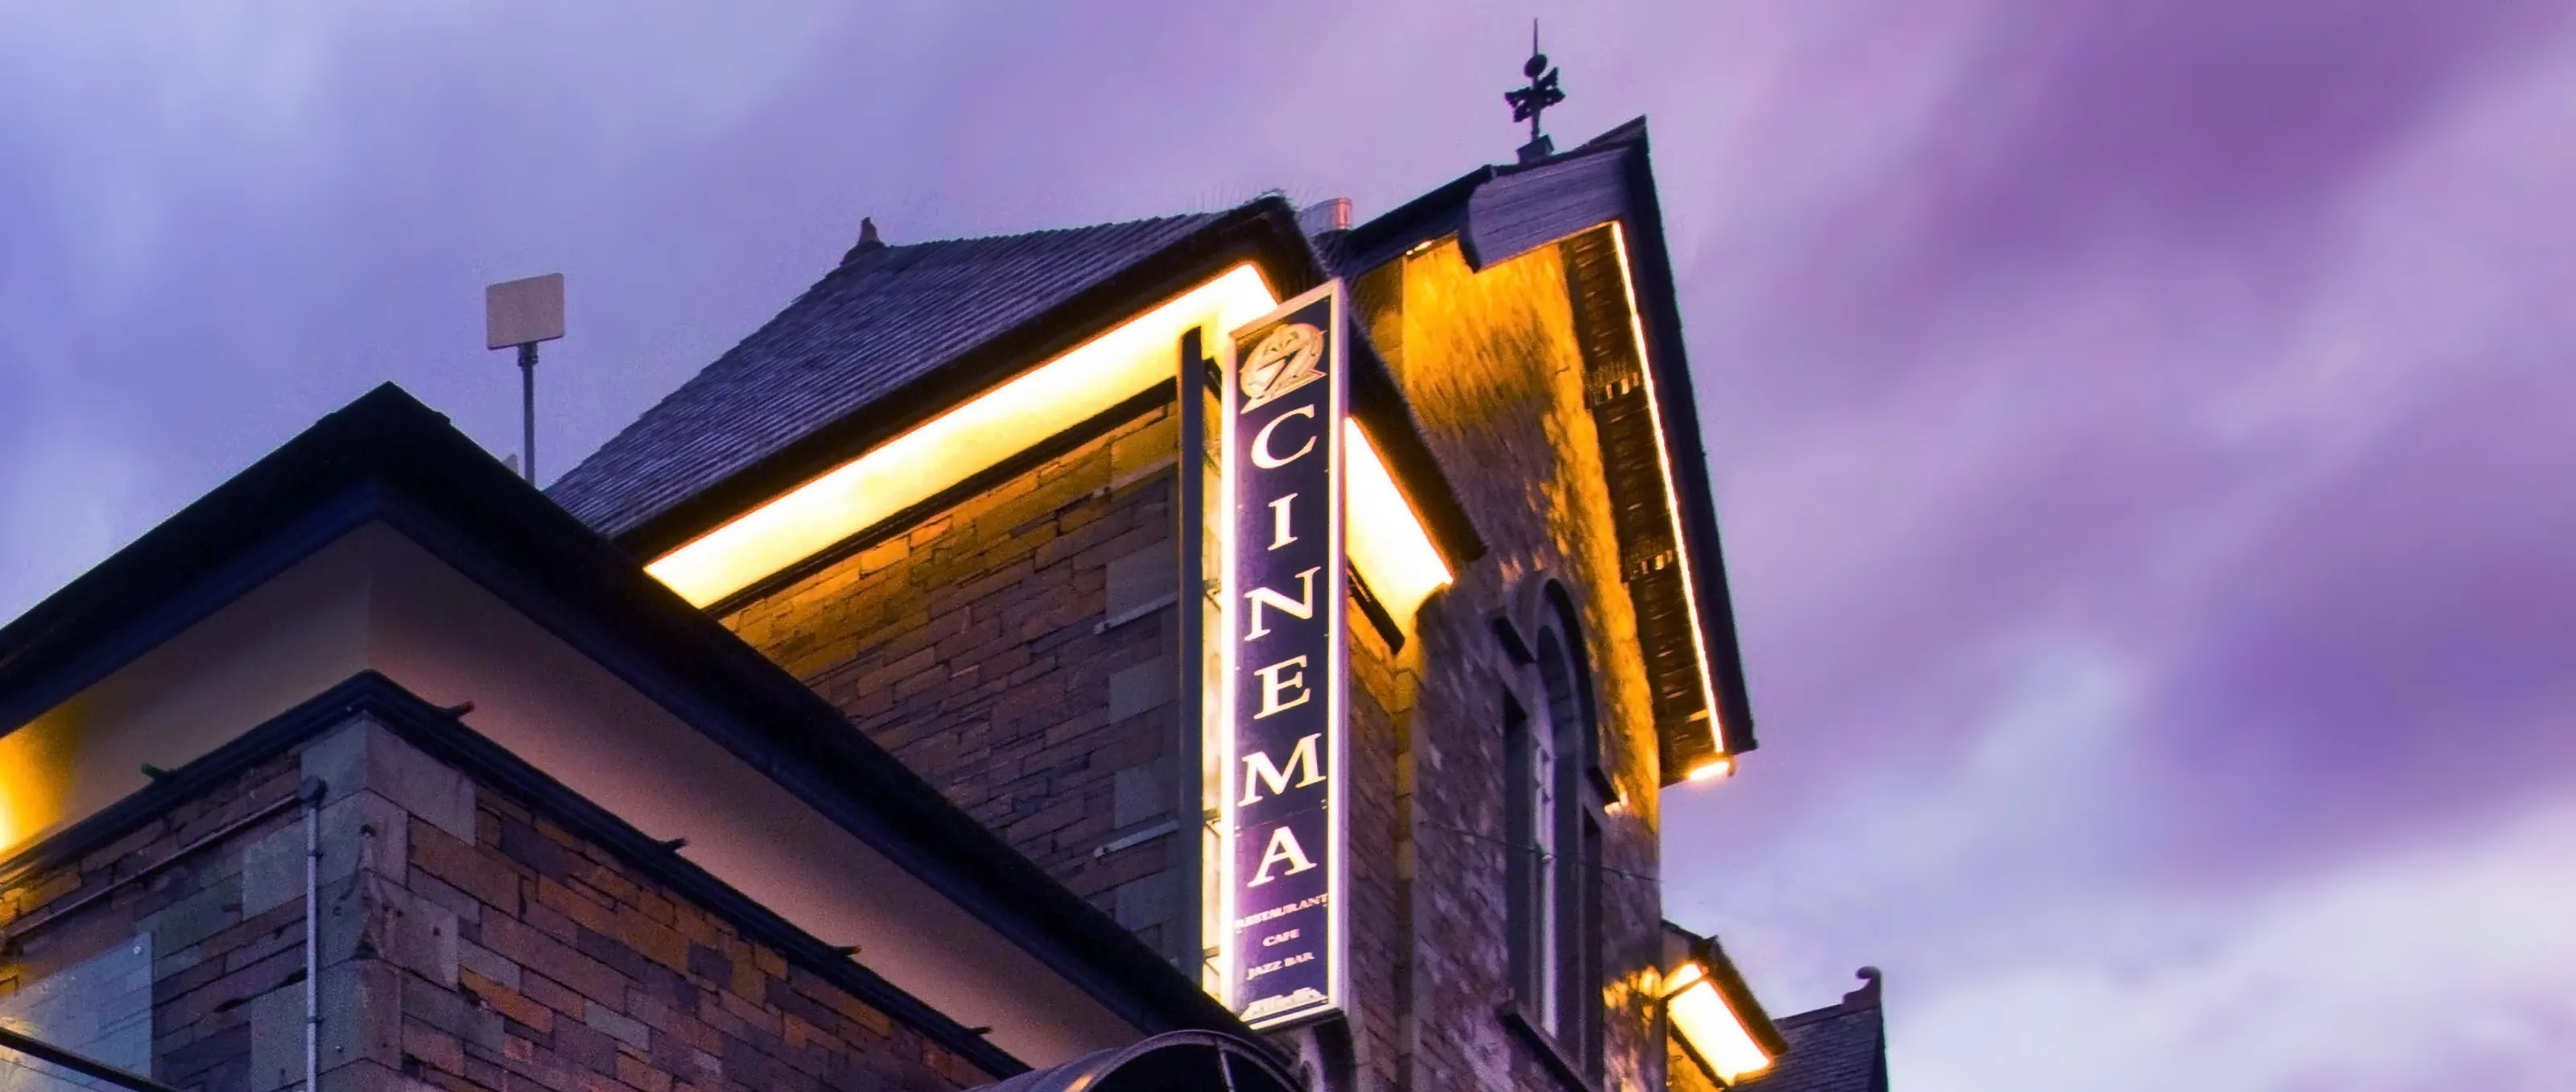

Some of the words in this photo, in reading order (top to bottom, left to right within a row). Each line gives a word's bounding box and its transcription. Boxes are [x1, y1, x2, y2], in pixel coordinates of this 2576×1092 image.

[1238, 403, 1327, 888] CINEMA
[1262, 929, 1300, 947] CAFE
[1246, 960, 1282, 981] JAZZ
[1284, 952, 1316, 967] BAR
